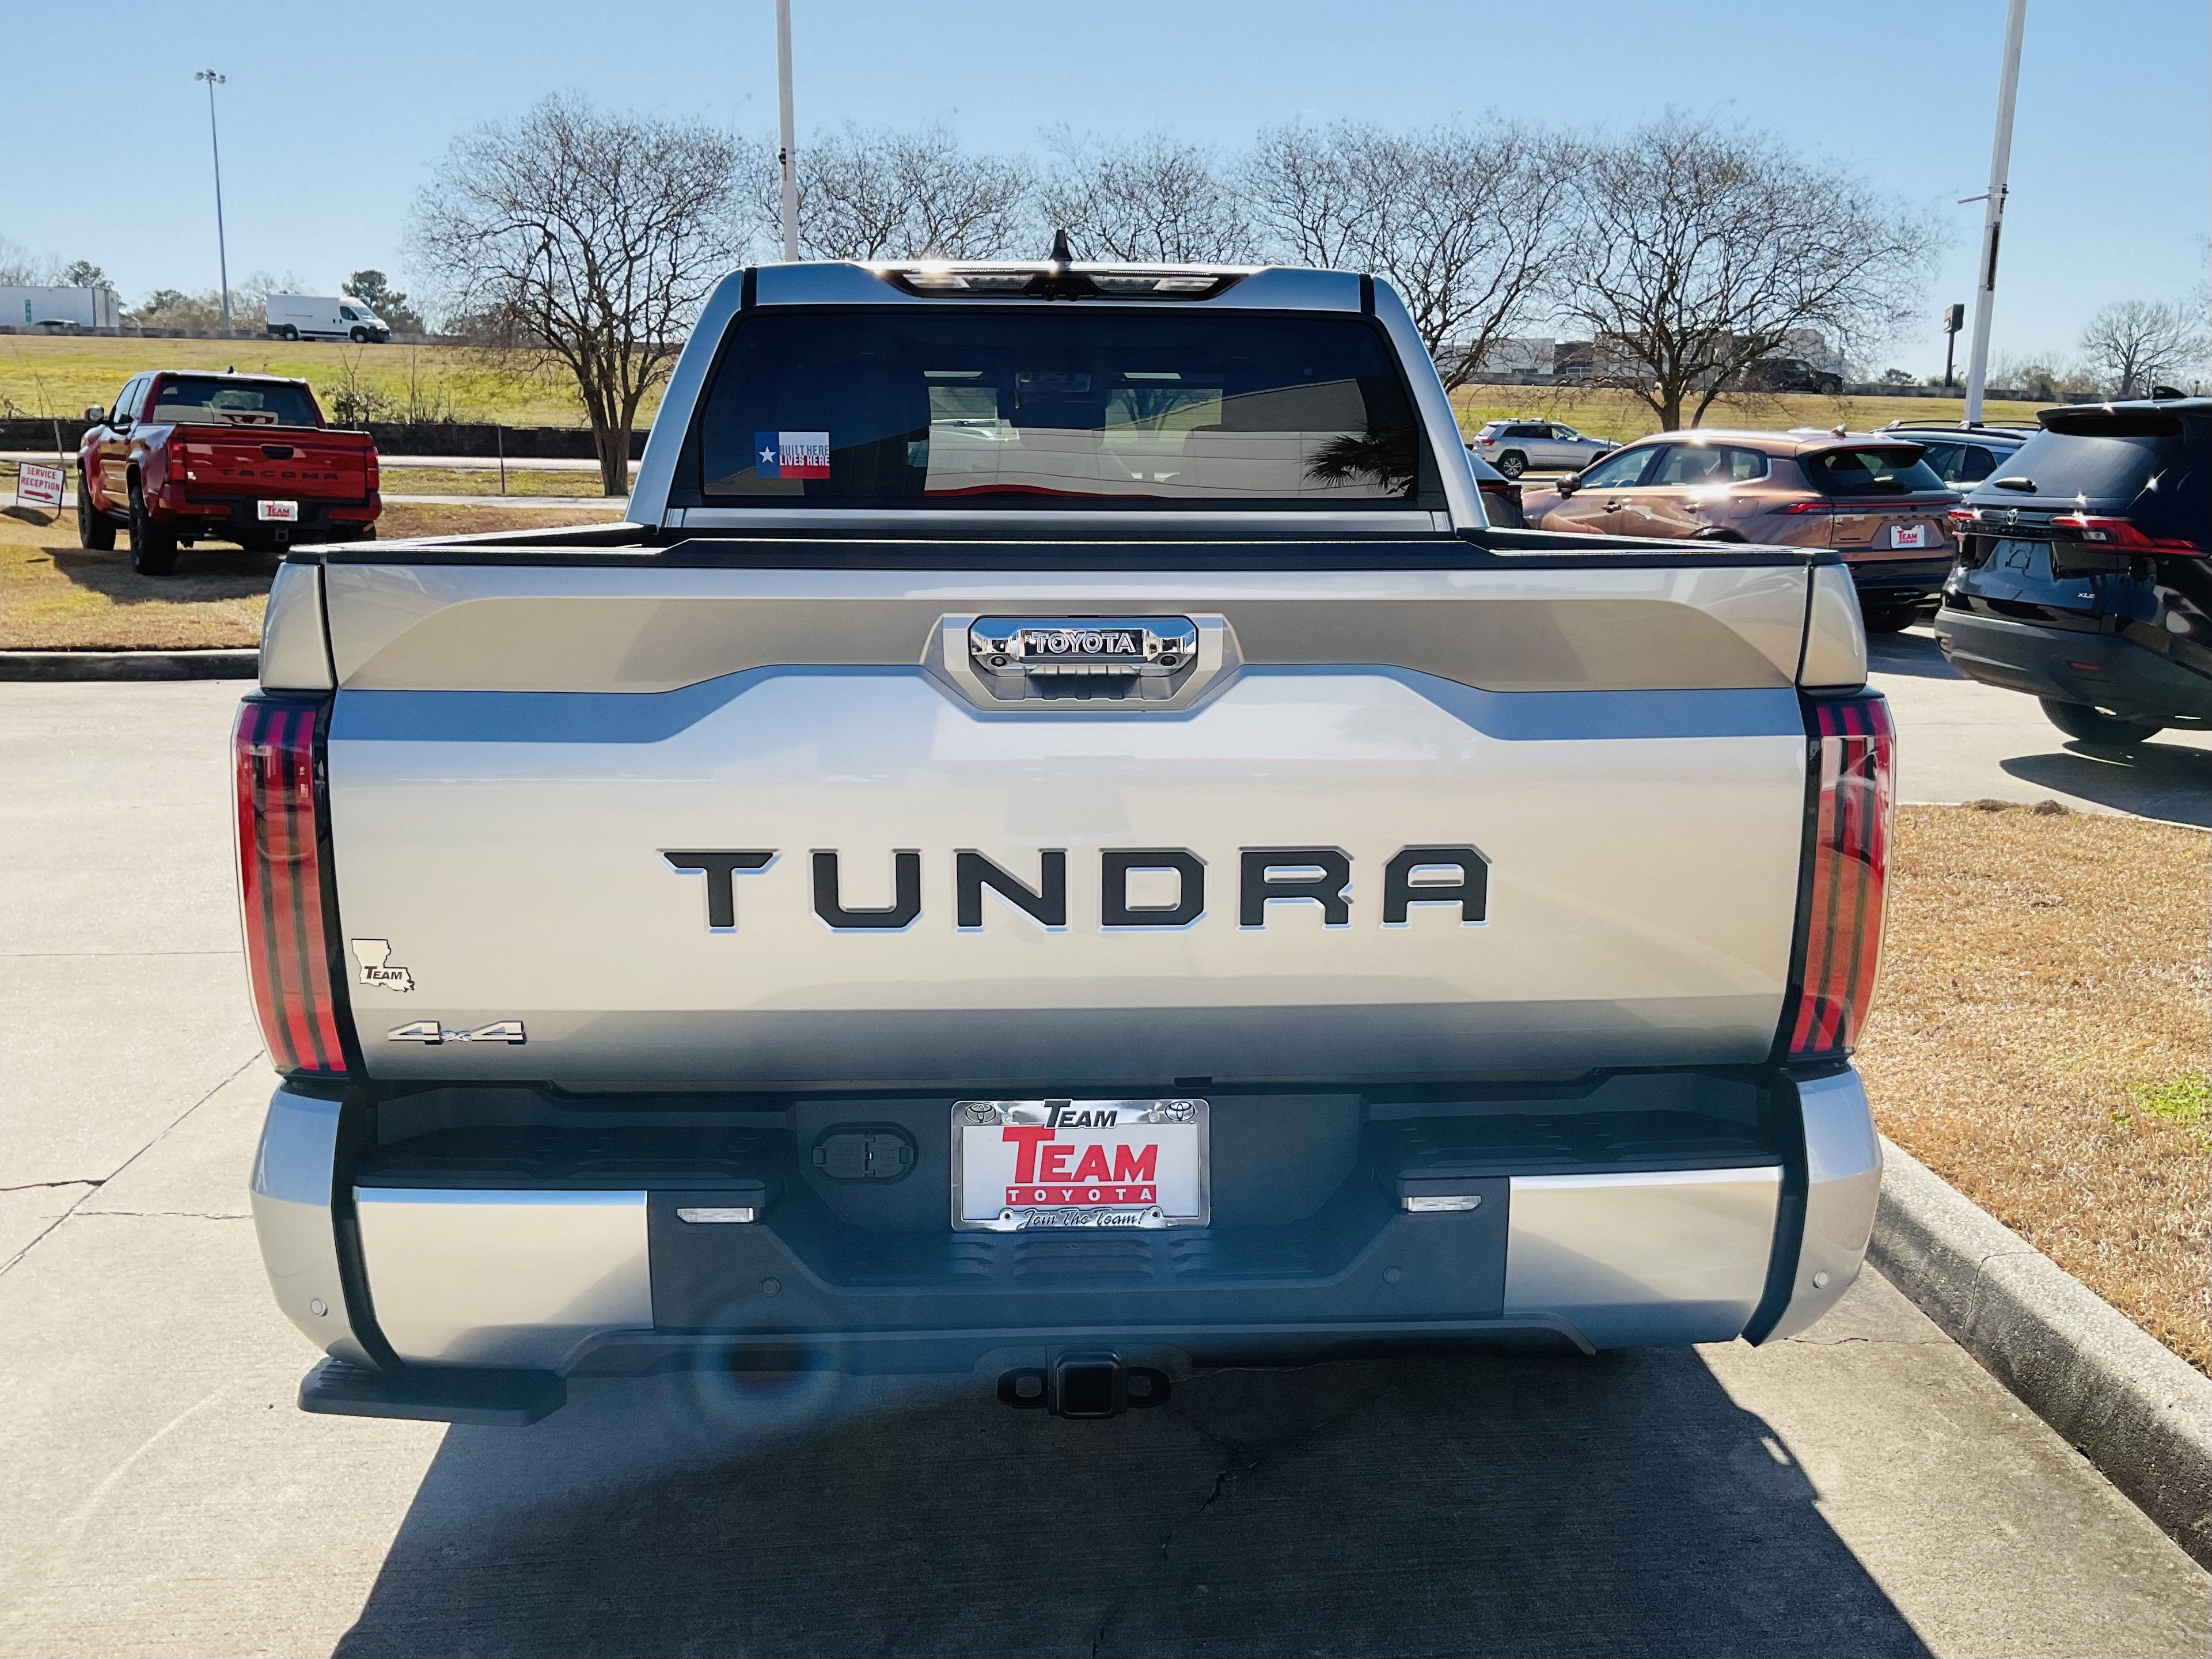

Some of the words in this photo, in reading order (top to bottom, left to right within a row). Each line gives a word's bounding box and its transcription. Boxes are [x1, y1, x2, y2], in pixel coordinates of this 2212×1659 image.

[779, 445, 805, 455] BUILT
[807, 445, 829, 455] HERE
[779, 455, 805, 466] LIVES
[807, 455, 830, 466] HERE
[27, 466, 56, 480] SERVICE
[218, 469, 339, 480] TACOMA
[21, 476, 60, 491] RECEPTION
[266, 505, 290, 514] TEAM
[1898, 530, 1917, 540] TEAM
[1031, 630, 1136, 654] TOYOTA
[657, 848, 1490, 933] TUNDRA
[365, 966, 403, 980] TEAM
[1043, 1099, 1118, 1128] TEAM
[1002, 1126, 1158, 1184] TEAM
[1008, 1188, 1152, 1202] TOYOTA
[1016, 1209, 1057, 1231] Join
[1059, 1208, 1090, 1226] The
[1093, 1208, 1147, 1226] Team!
